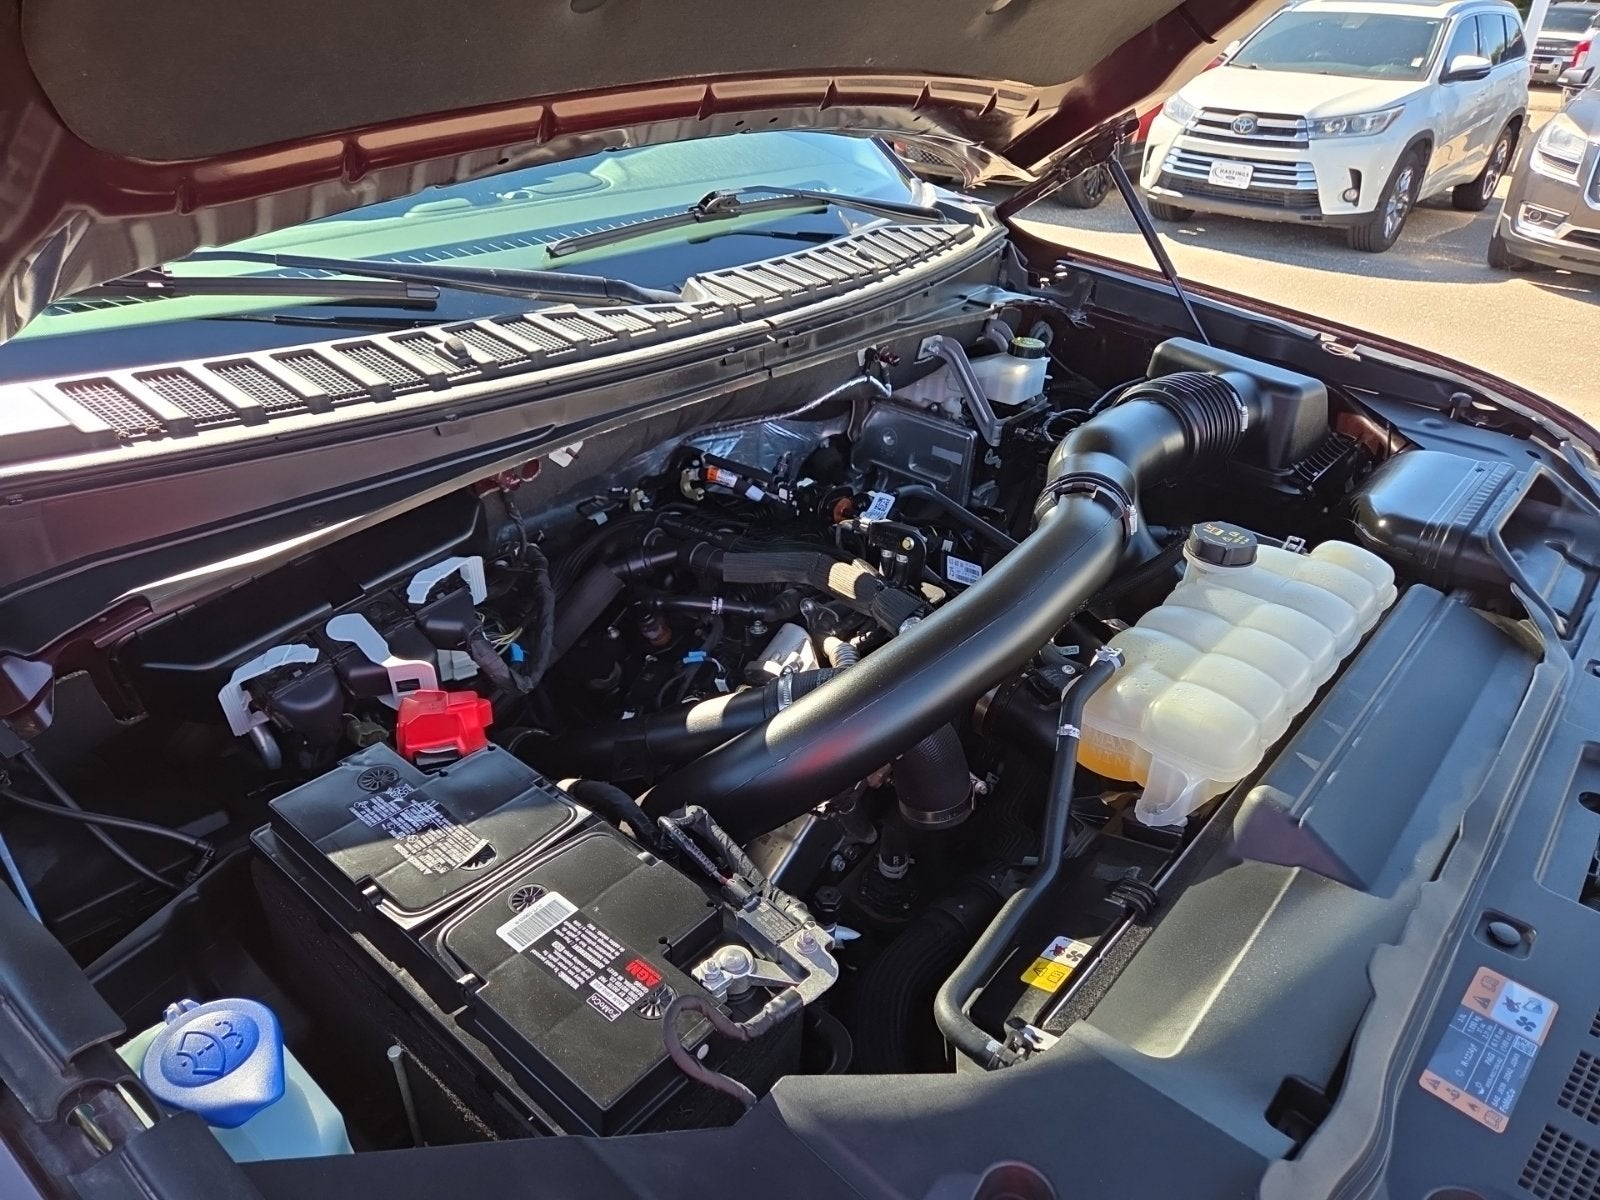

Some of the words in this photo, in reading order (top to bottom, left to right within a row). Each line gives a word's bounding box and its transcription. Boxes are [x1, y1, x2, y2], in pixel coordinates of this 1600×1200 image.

[1219, 168, 1249, 177] HASTINGS
[625, 961, 658, 987] AGM
[591, 995, 621, 1019] FoMoCo
[1461, 1043, 1479, 1068] R-1234yf
[1484, 1052, 1495, 1066] PAG
[1499, 1087, 1516, 1113] FoMoCo
